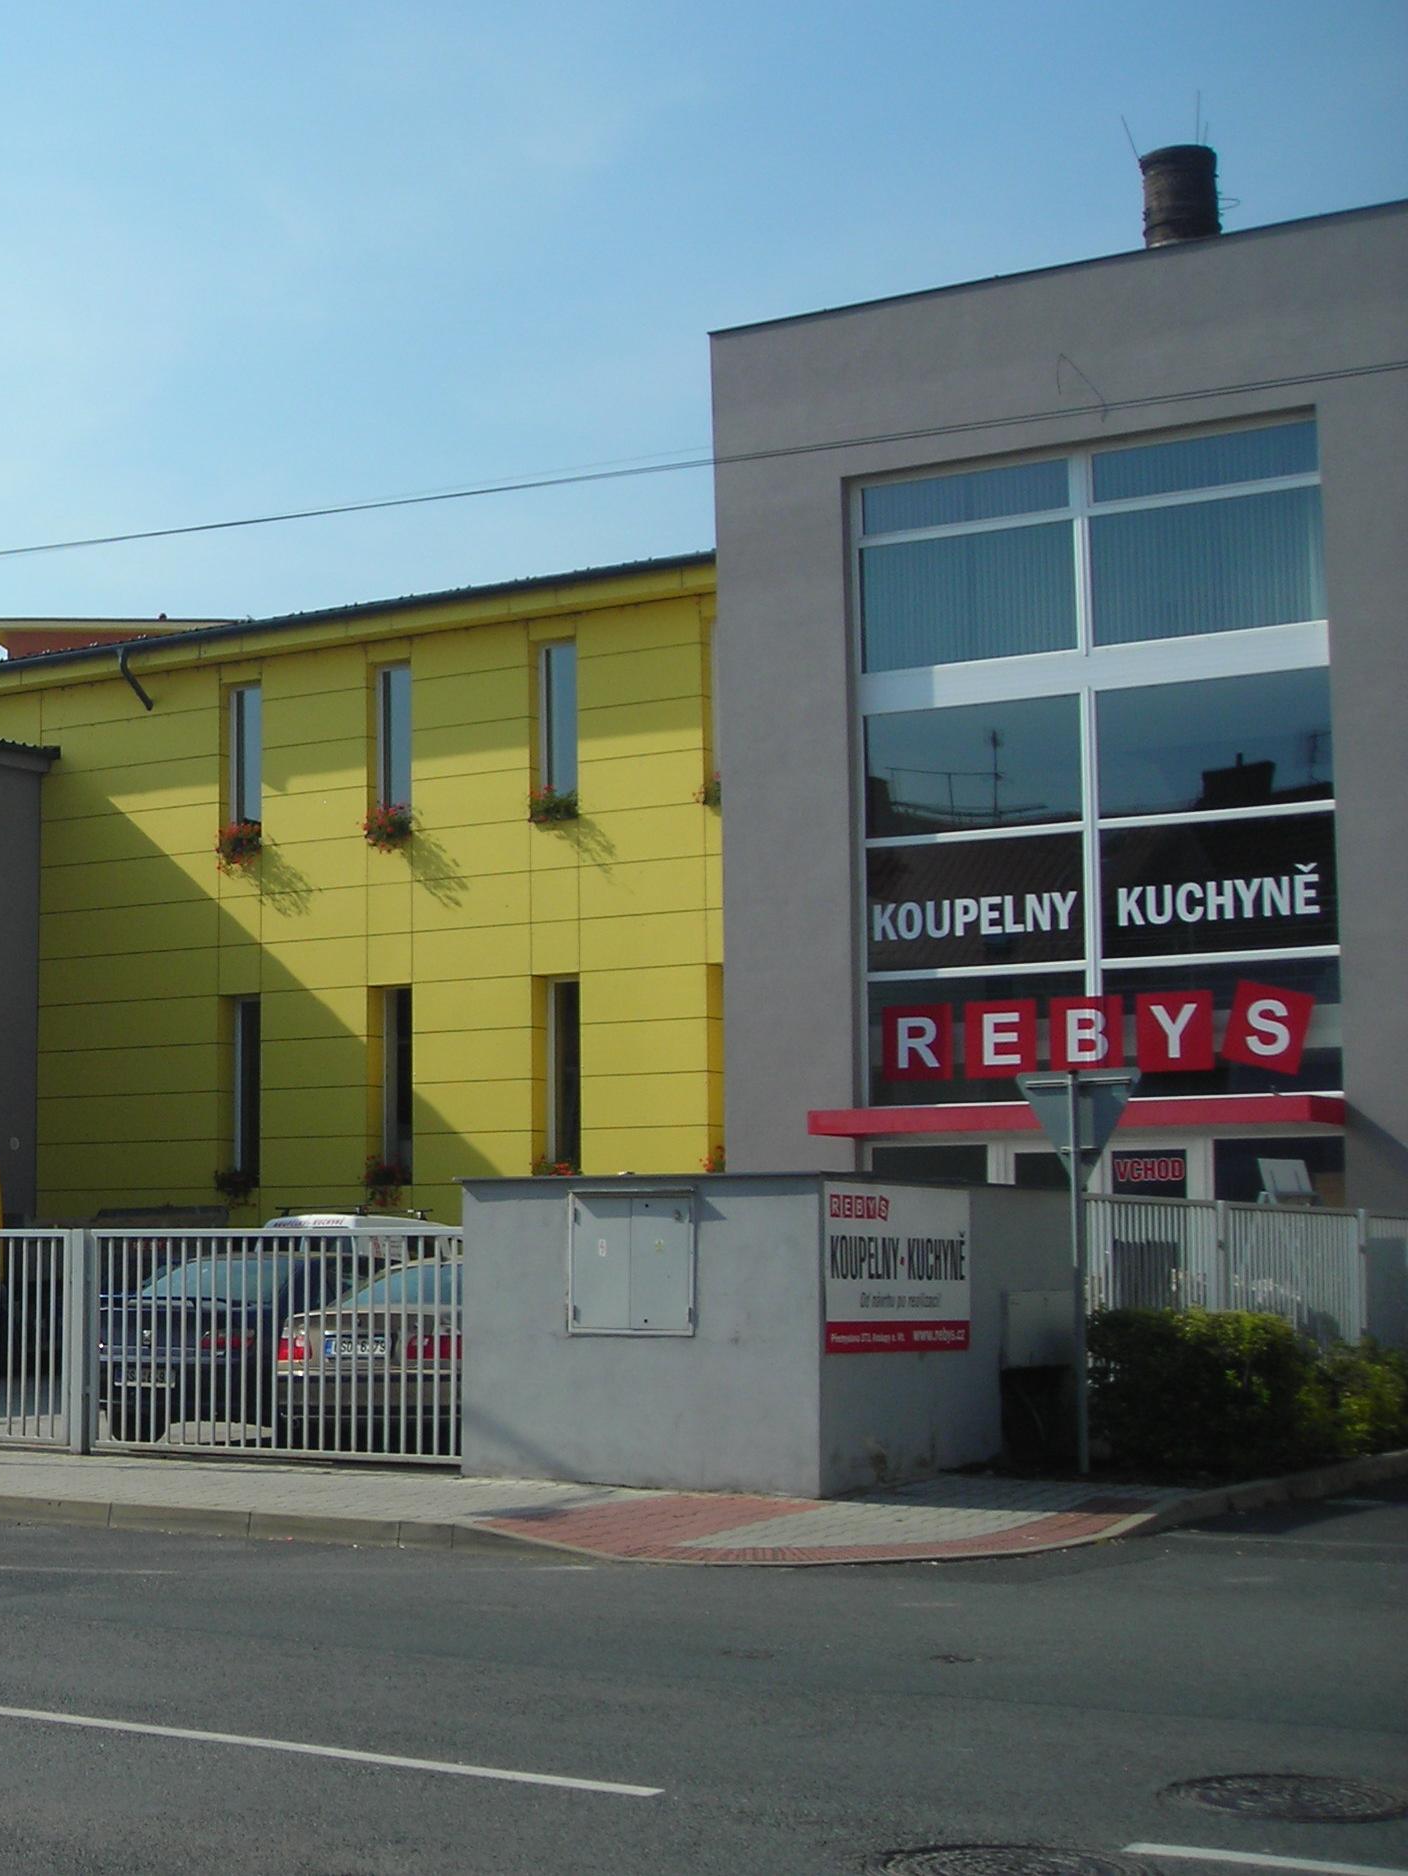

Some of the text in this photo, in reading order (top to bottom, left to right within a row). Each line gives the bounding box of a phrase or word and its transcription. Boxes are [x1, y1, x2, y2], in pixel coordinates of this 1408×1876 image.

[873, 862, 1320, 942] KOUPELNY KUCHYNĚ
[896, 999, 1292, 1070] REBYS
[1114, 1157, 1185, 1182] VCHOD
[831, 1197, 888, 1220] REBYS
[830, 1235, 900, 1280] KOUPELNY
[907, 1230, 966, 1281] KUCHYNĚ
